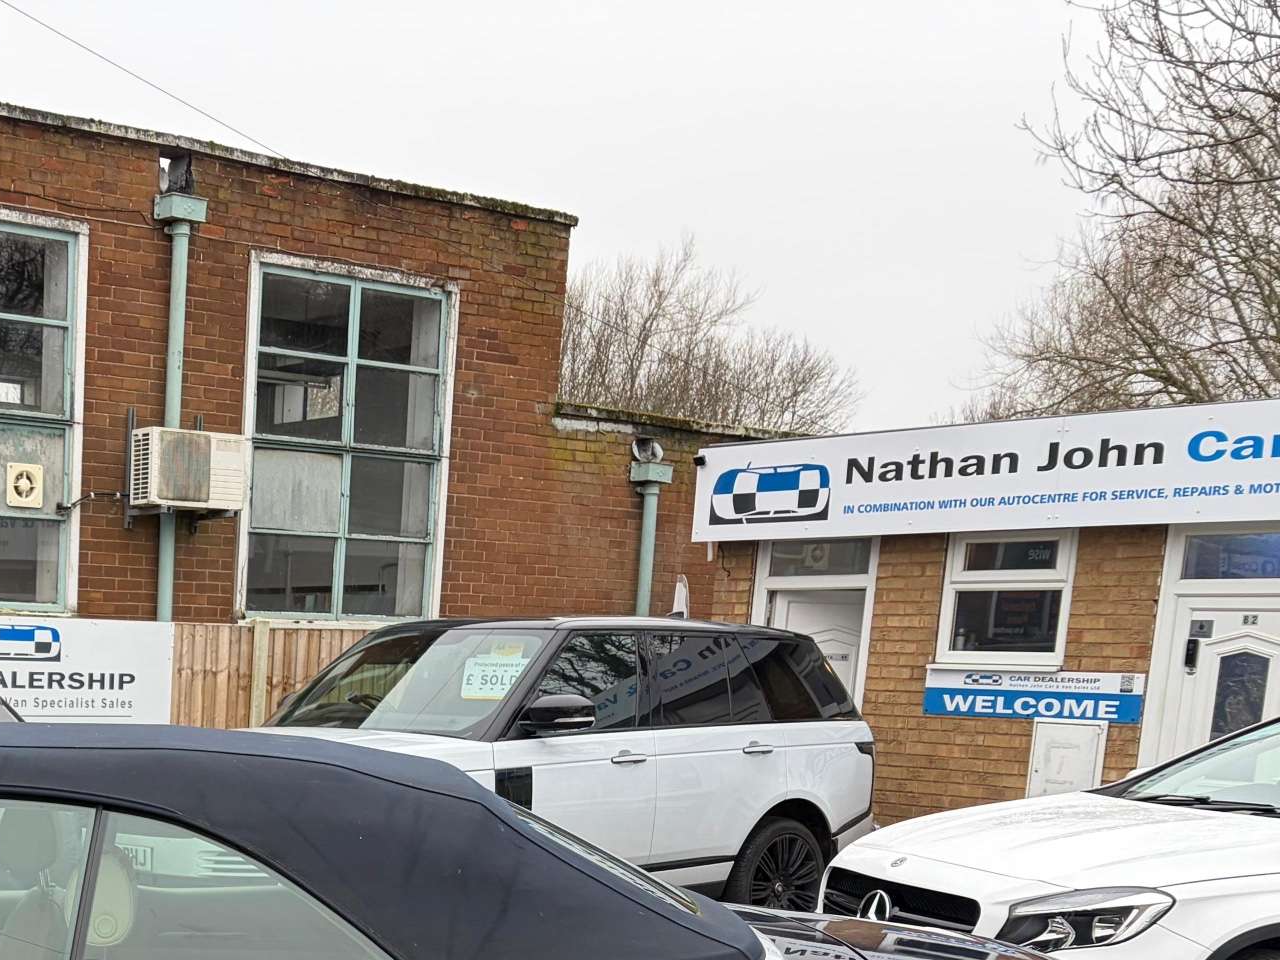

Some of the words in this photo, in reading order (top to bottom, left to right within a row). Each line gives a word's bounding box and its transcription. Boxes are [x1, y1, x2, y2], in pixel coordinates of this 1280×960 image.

[845, 451, 1019, 484] Nathan
[1036, 438, 1165, 471] John
[843, 505, 855, 514] IN
[857, 501, 935, 514] COMBINATION
[938, 499, 967, 509] WITH
[970, 497, 995, 507] OUR
[998, 492, 1079, 506] AUTOCENTRE
[1082, 491, 1109, 501] FOR
[1111, 488, 1169, 500] SERVICE,
[1173, 485, 1230, 497] REPAIRS
[1235, 485, 1245, 495] &
[1009, 675, 1031, 683] CAR
[1034, 676, 1101, 684] DEALERSHIP
[33, 697, 96, 709] Specialist
[101, 698, 133, 709] Sales
[943, 694, 1120, 719] WELCOME
